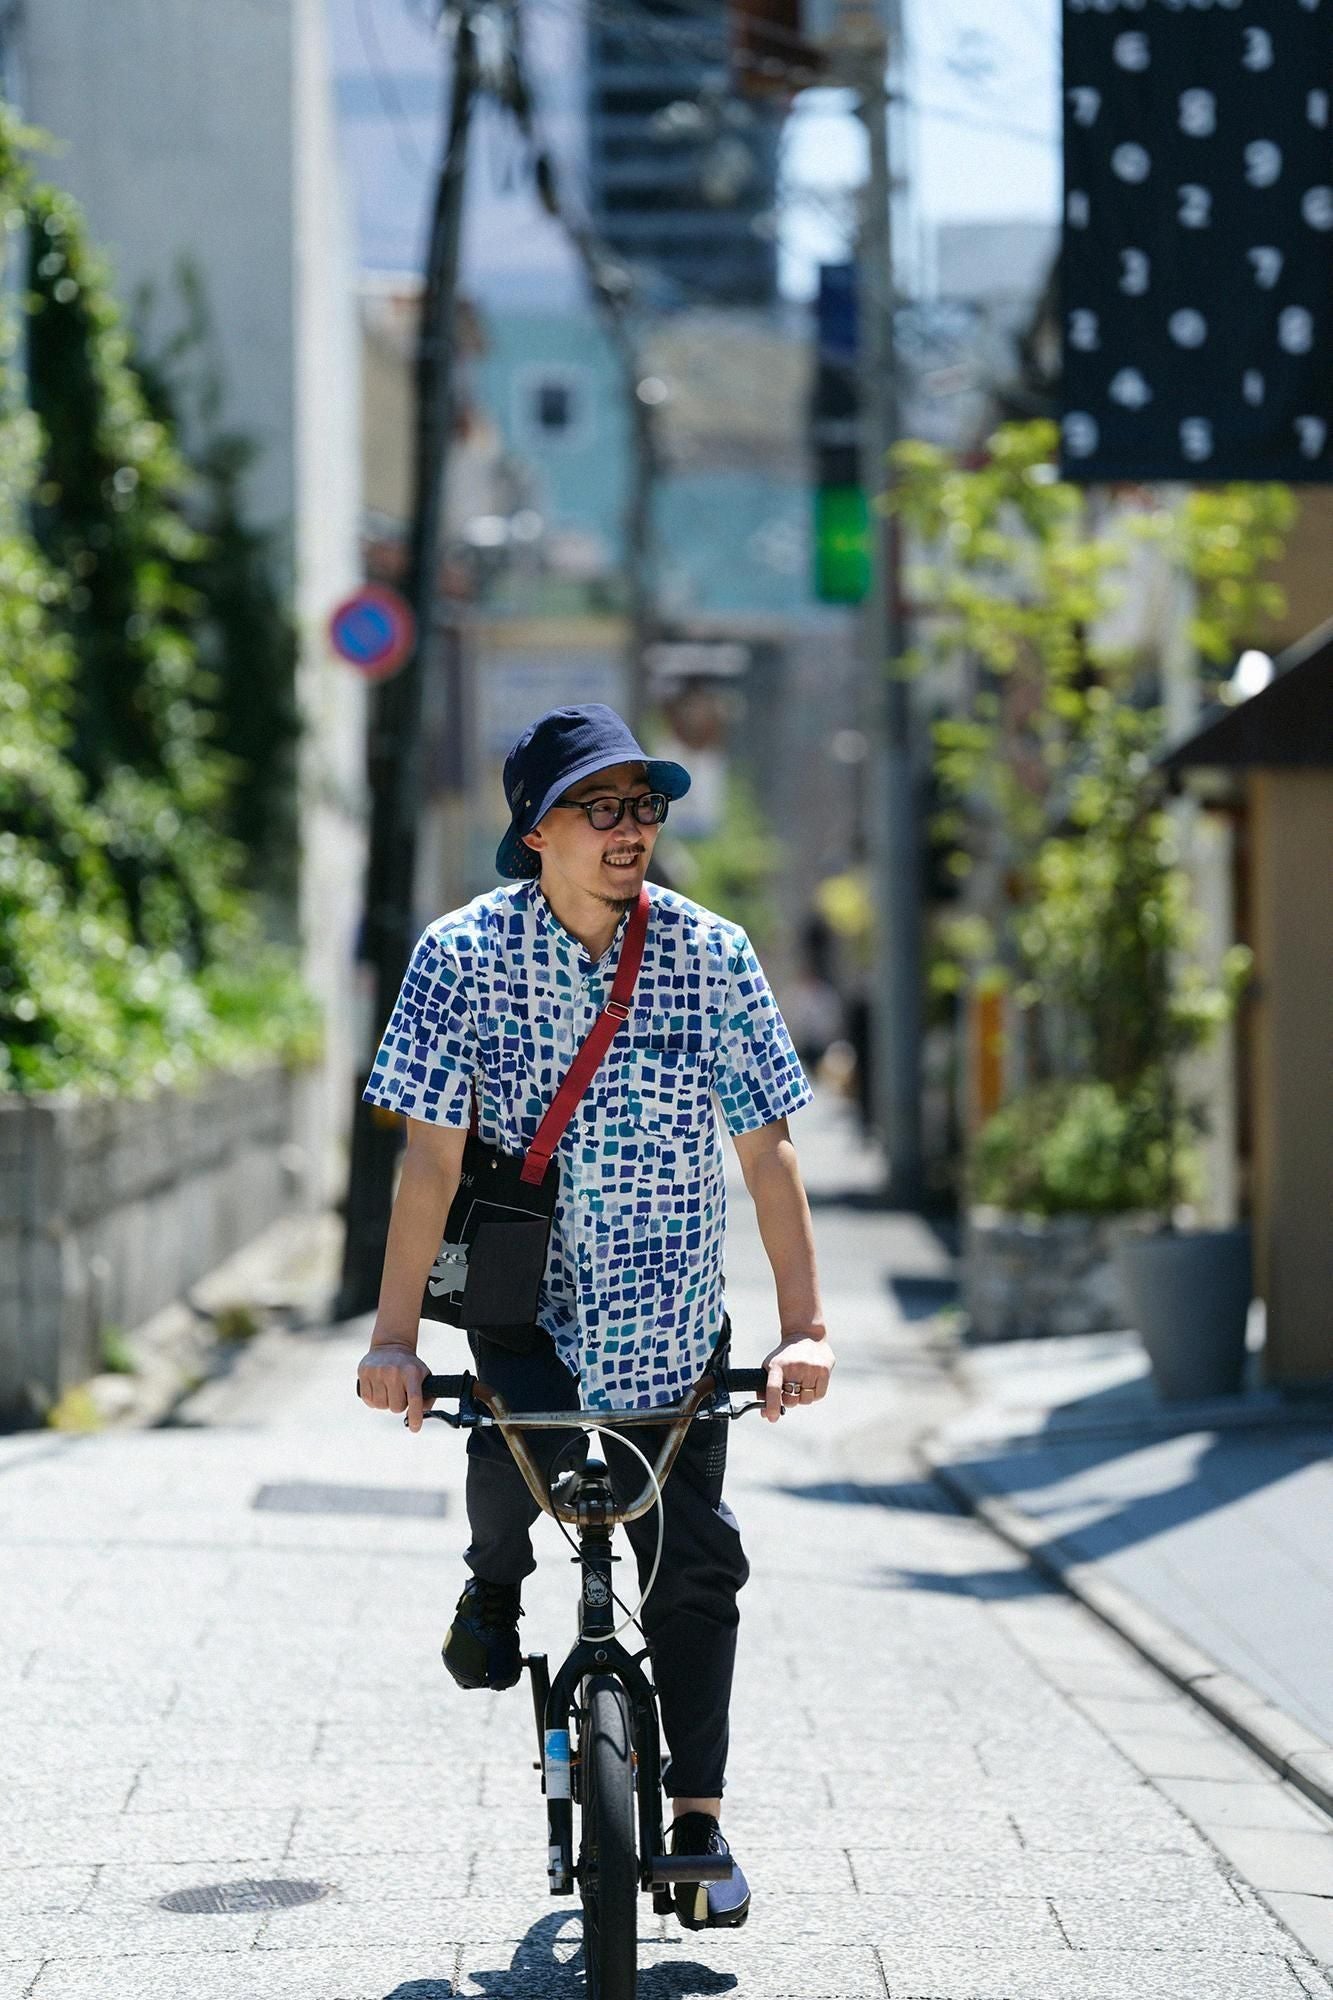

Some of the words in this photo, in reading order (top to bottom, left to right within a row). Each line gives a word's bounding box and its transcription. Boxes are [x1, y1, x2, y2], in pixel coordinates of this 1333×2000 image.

[1243, 27, 1273, 71] 3
[1245, 140, 1282, 187] 9
[1179, 184, 1211, 228] 2
[1120, 248, 1149, 295] 3
[1248, 246, 1282, 288] 7
